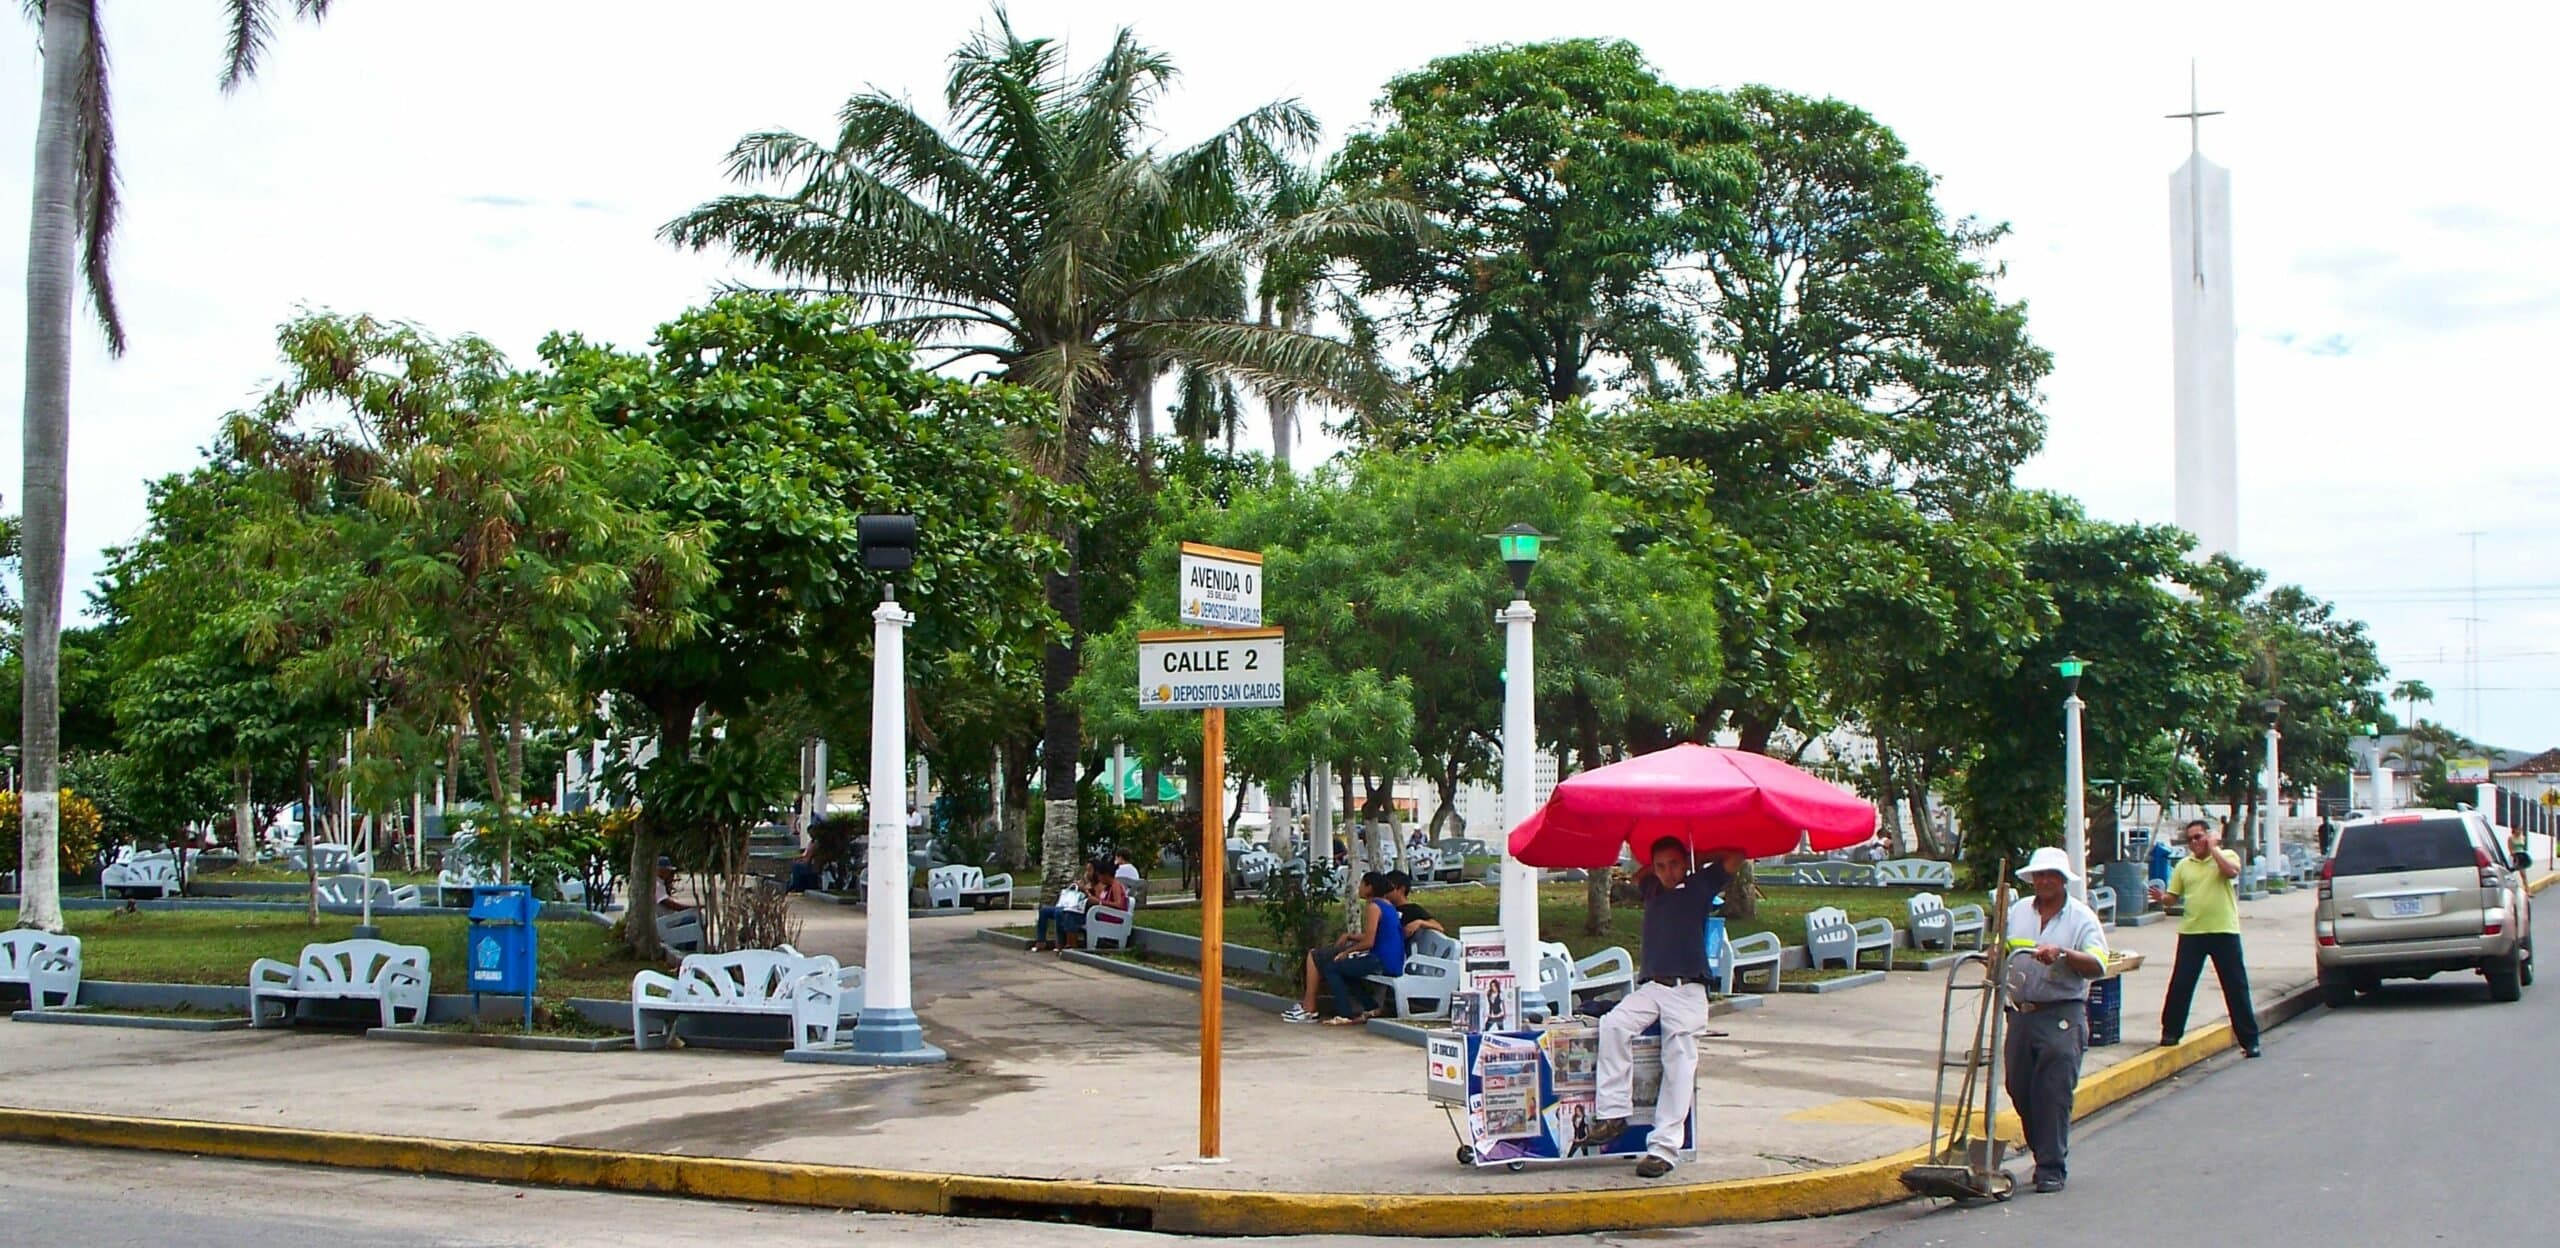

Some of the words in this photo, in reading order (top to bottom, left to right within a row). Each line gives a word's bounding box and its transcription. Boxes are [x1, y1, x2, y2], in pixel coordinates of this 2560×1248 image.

[1190, 565, 1240, 593] AVENIDA
[1245, 573, 1253, 595] 0
[1207, 590, 1214, 598] 25
[1215, 591, 1222, 599] DE
[1223, 592, 1237, 601] JULIO
[1201, 601, 1227, 620] DEPOSITO
[1228, 605, 1239, 621] SAN
[1240, 607, 1260, 624] CARLOS
[1164, 650, 1229, 673] CALLE
[1245, 649, 1258, 670] 2
[1173, 684, 1220, 702] DEPOSITO
[1221, 684, 1241, 700] SAN
[1243, 682, 1281, 700] CARLOS
